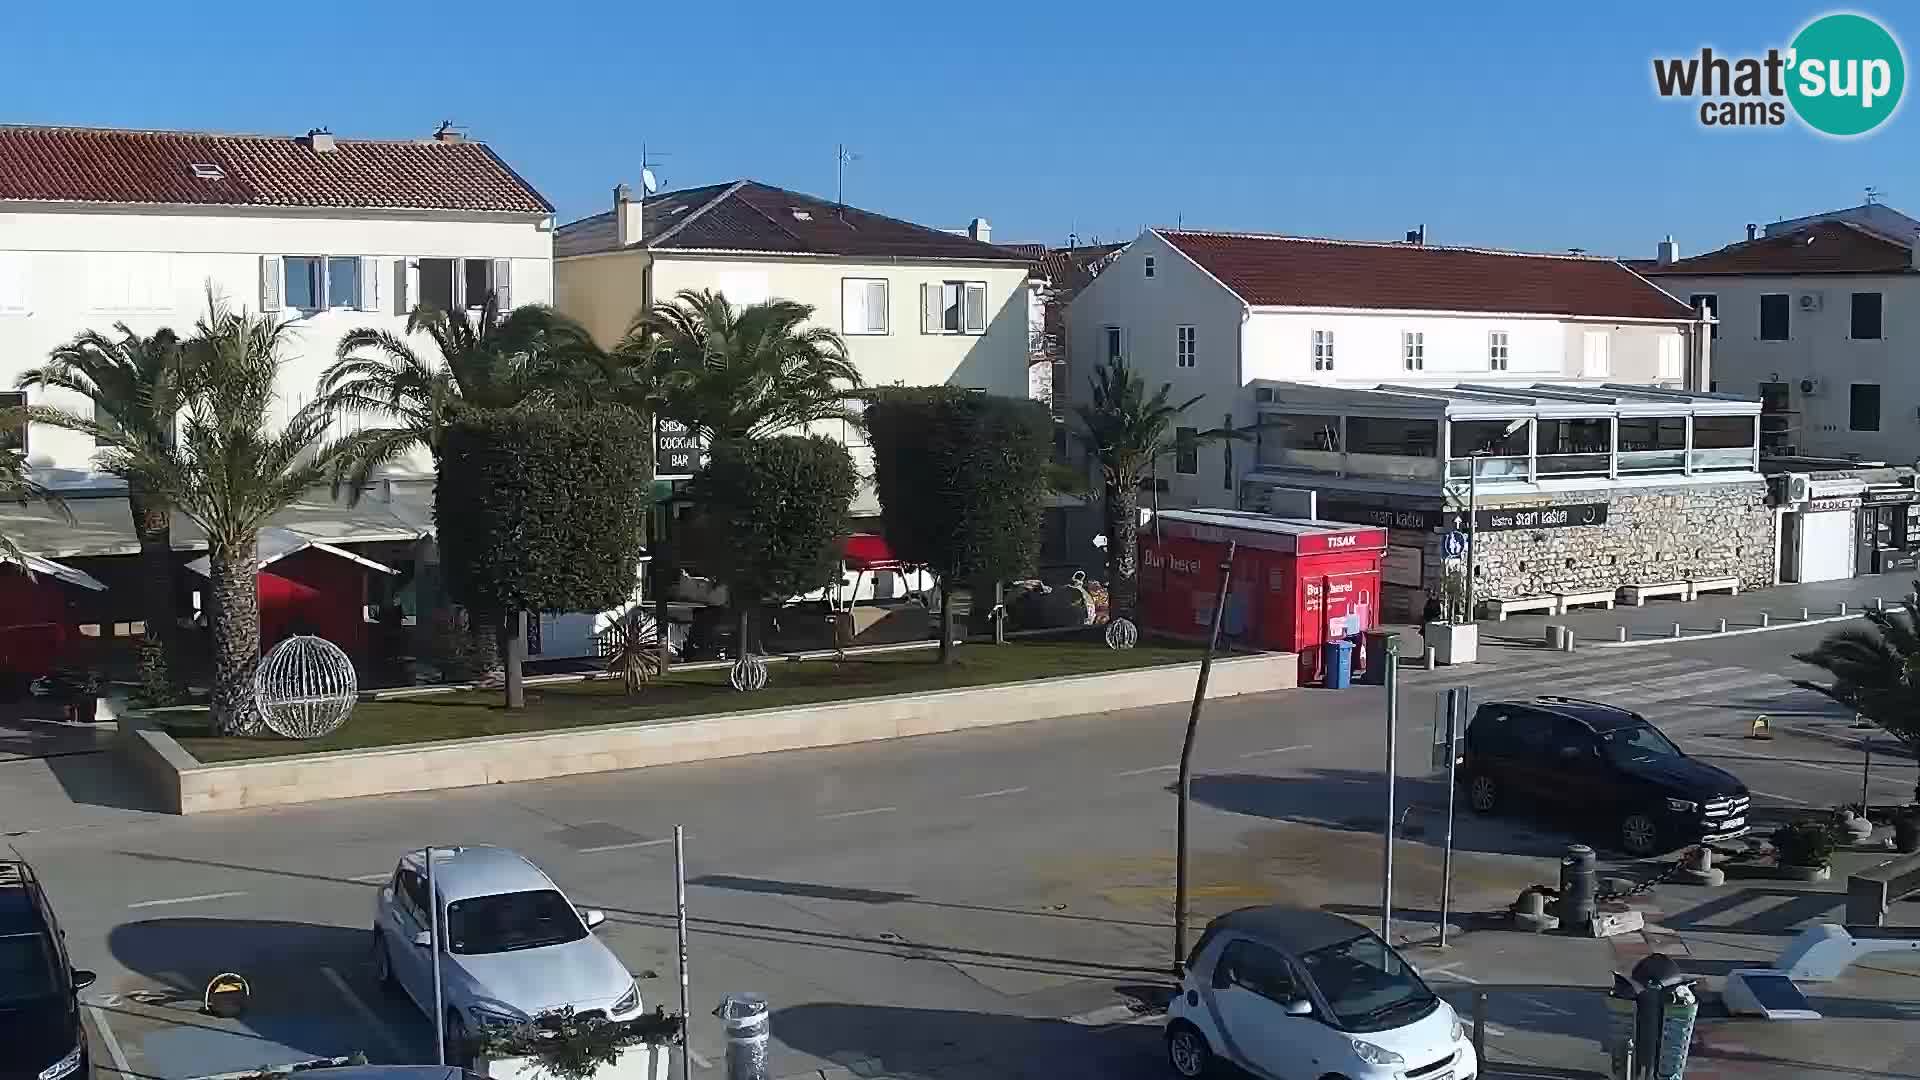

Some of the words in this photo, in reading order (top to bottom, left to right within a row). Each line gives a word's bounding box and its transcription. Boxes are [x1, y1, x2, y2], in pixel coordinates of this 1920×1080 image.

[660, 436, 699, 450] COCKTAIL
[671, 454, 689, 467] BAR
[1812, 499, 1853, 510] MARKET
[1491, 514, 1513, 527] bistro
[1327, 535, 1356, 548] TISAK
